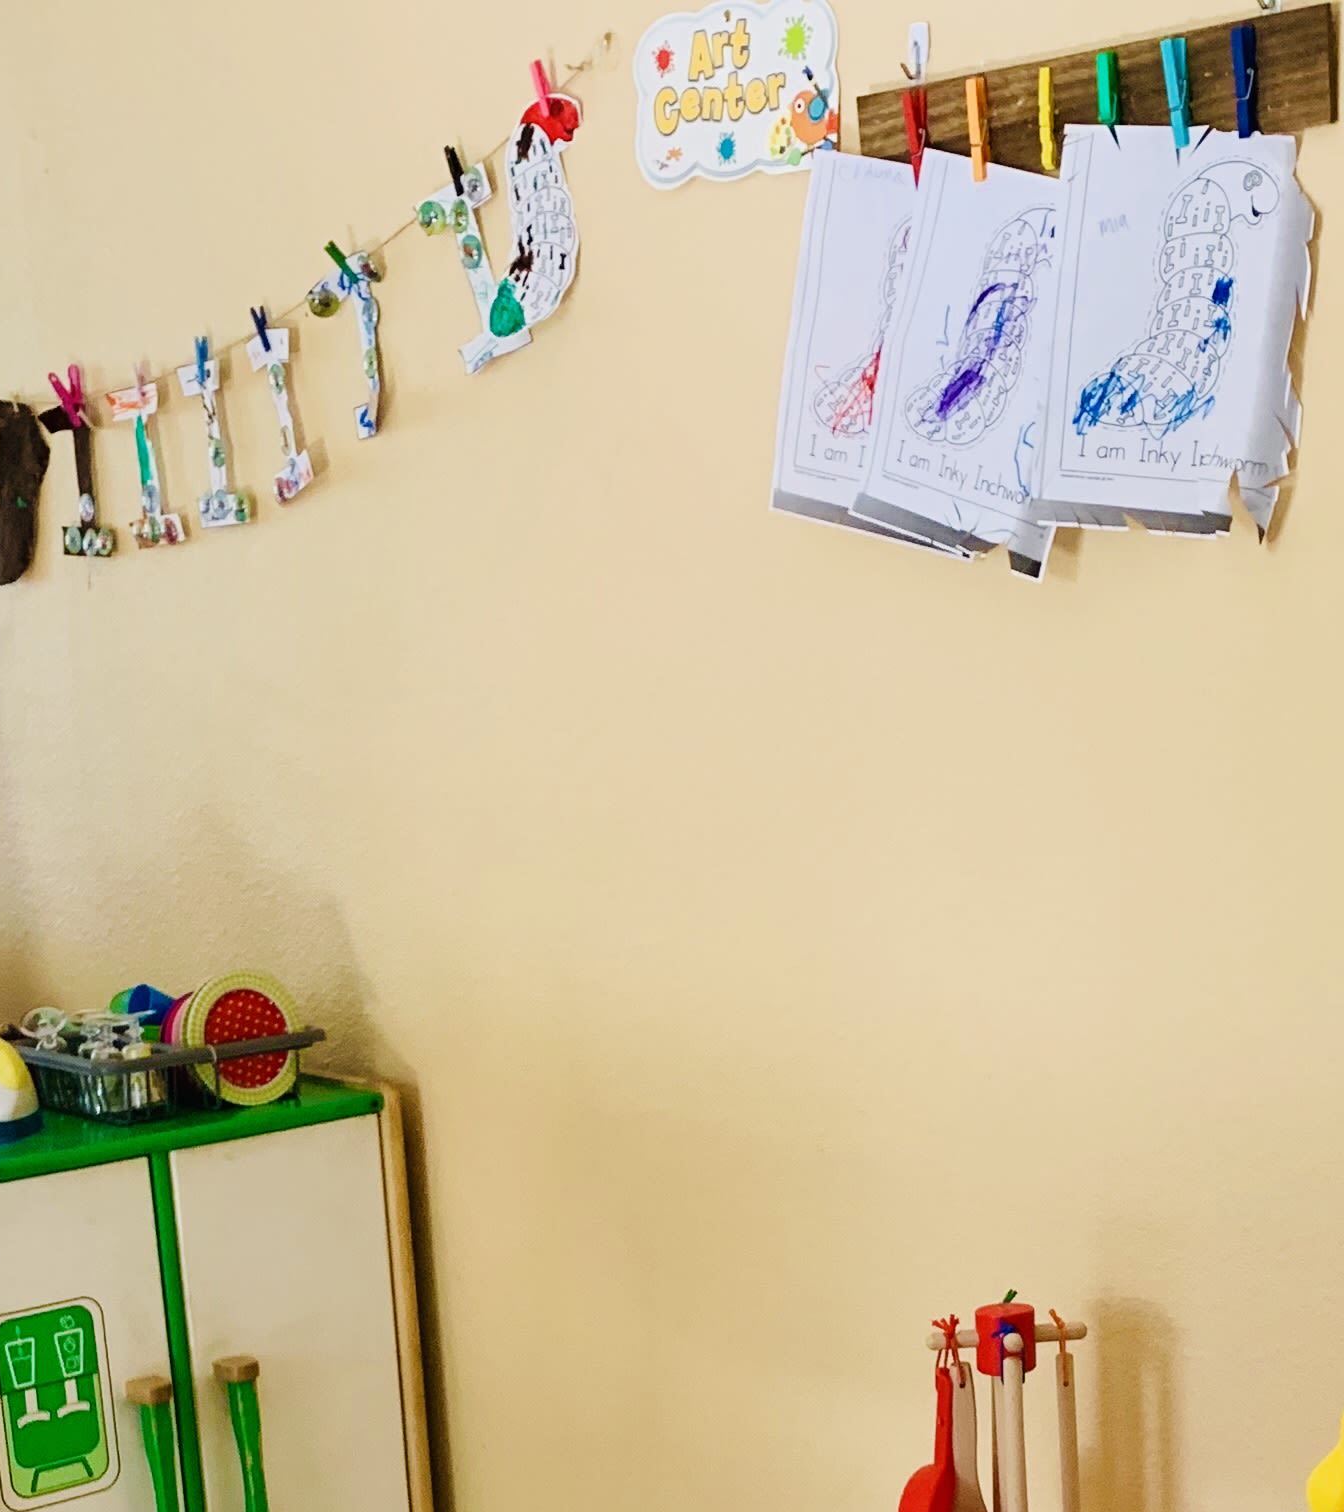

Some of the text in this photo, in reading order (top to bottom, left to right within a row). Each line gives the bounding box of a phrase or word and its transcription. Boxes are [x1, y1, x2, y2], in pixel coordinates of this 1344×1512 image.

[687, 18, 751, 82] Art
[653, 70, 787, 137] Center
[809, 434, 817, 457] I
[824, 446, 848, 463] am
[896, 439, 906, 463] I
[909, 453, 931, 472] am
[938, 454, 969, 492] Inky
[1078, 433, 1088, 458] I
[1096, 445, 1126, 461] am
[1138, 438, 1182, 473] Inky
